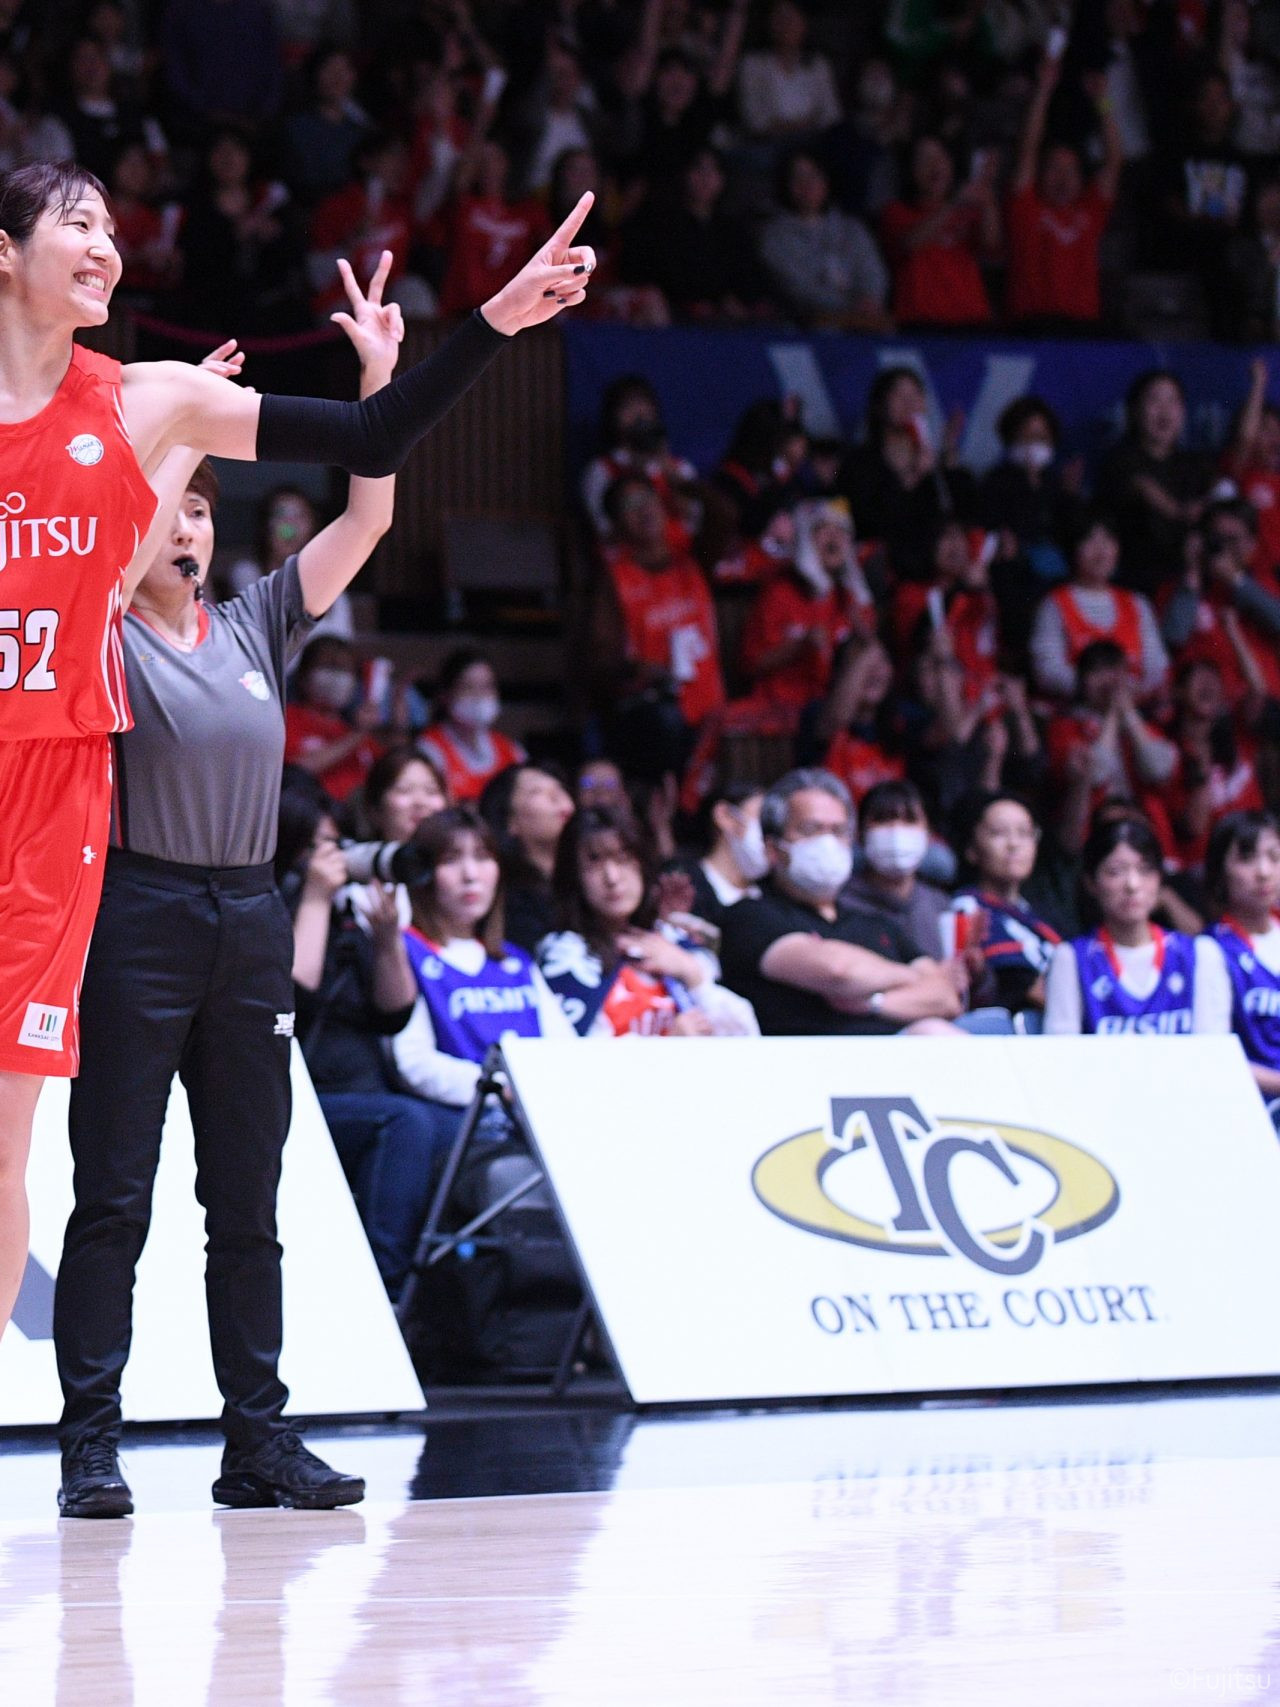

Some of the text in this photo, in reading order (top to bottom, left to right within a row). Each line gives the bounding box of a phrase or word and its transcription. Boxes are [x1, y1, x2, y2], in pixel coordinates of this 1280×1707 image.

[830, 1097, 1045, 1276] TC
[811, 1284, 1159, 1335] ON THE COURT
